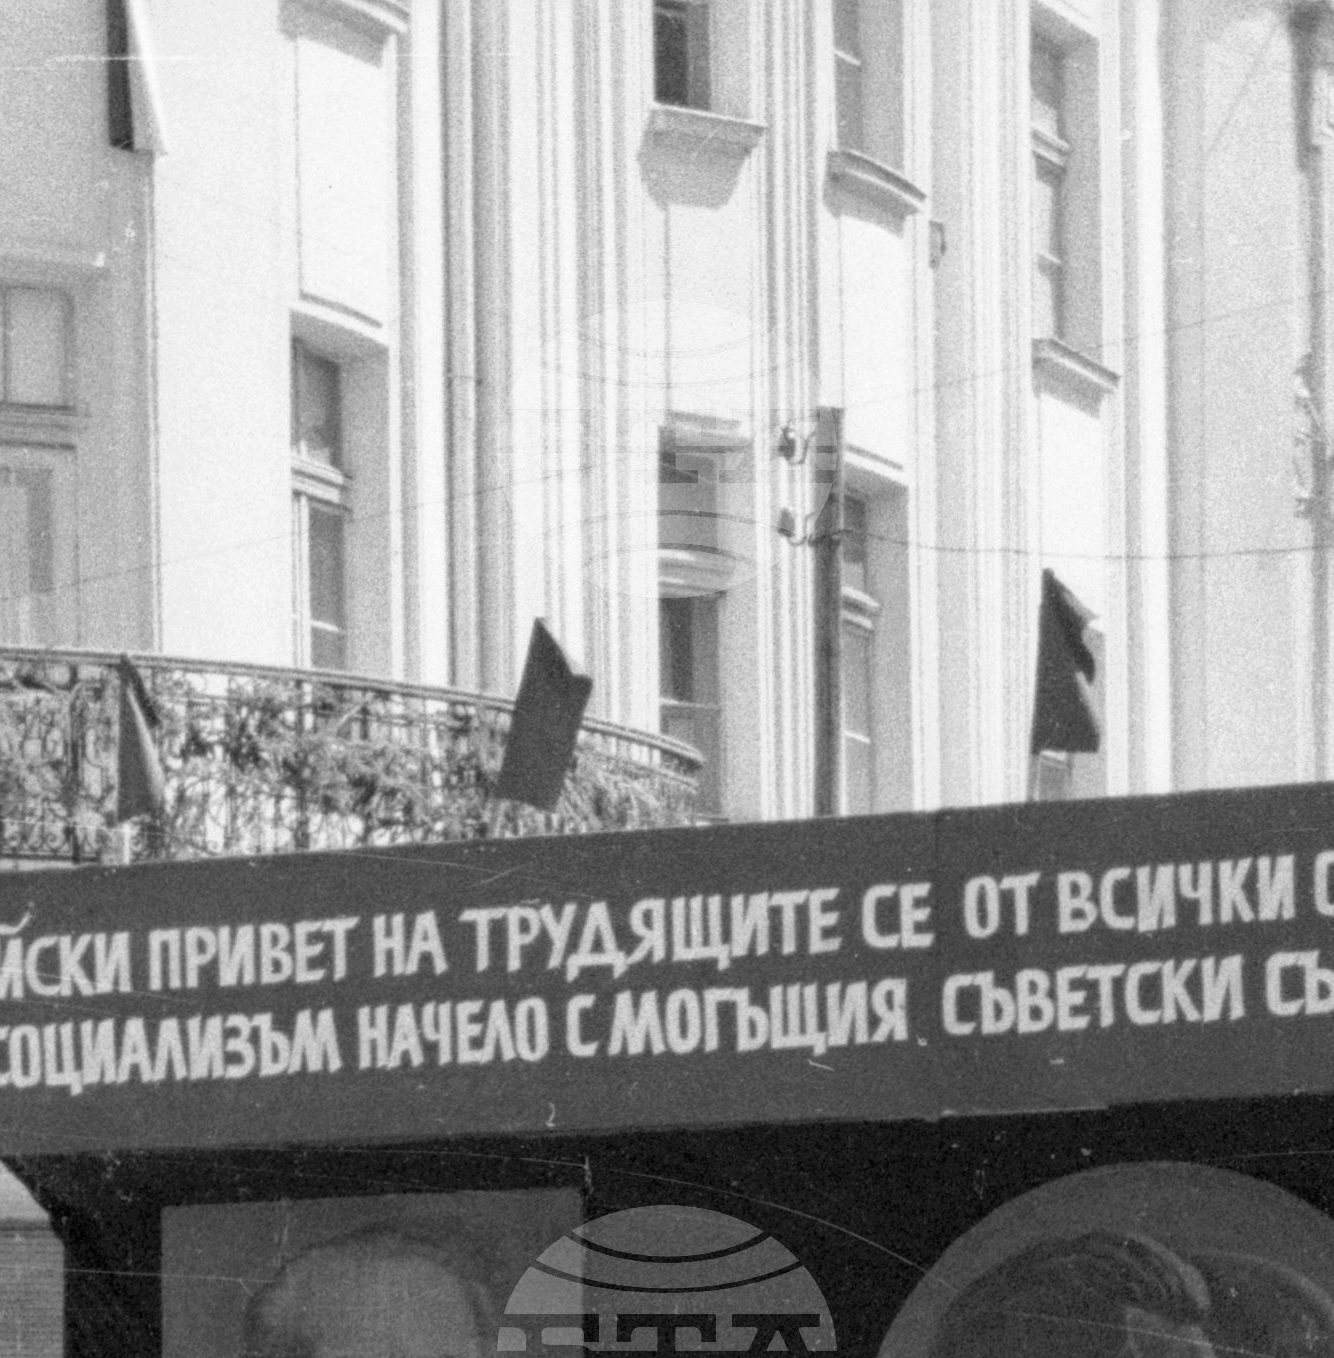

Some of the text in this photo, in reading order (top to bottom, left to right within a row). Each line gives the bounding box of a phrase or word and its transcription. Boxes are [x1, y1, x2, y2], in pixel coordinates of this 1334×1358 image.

[148, 915, 359, 991] ПРИВЕТ
[373, 910, 448, 977] НА
[459, 888, 841, 982] ТРУДЯЩИТЕ
[862, 882, 934, 949] СЕ
[964, 872, 1040, 938] ОТ
[1057, 854, 1295, 933] ВСИЧКИ
[357, 997, 549, 1070] НАЧЕЛО
[566, 994, 598, 1057] С
[608, 978, 908, 1056] МОГЪЩИЯ
[942, 954, 1245, 1035] СЪВЕТСКИ
